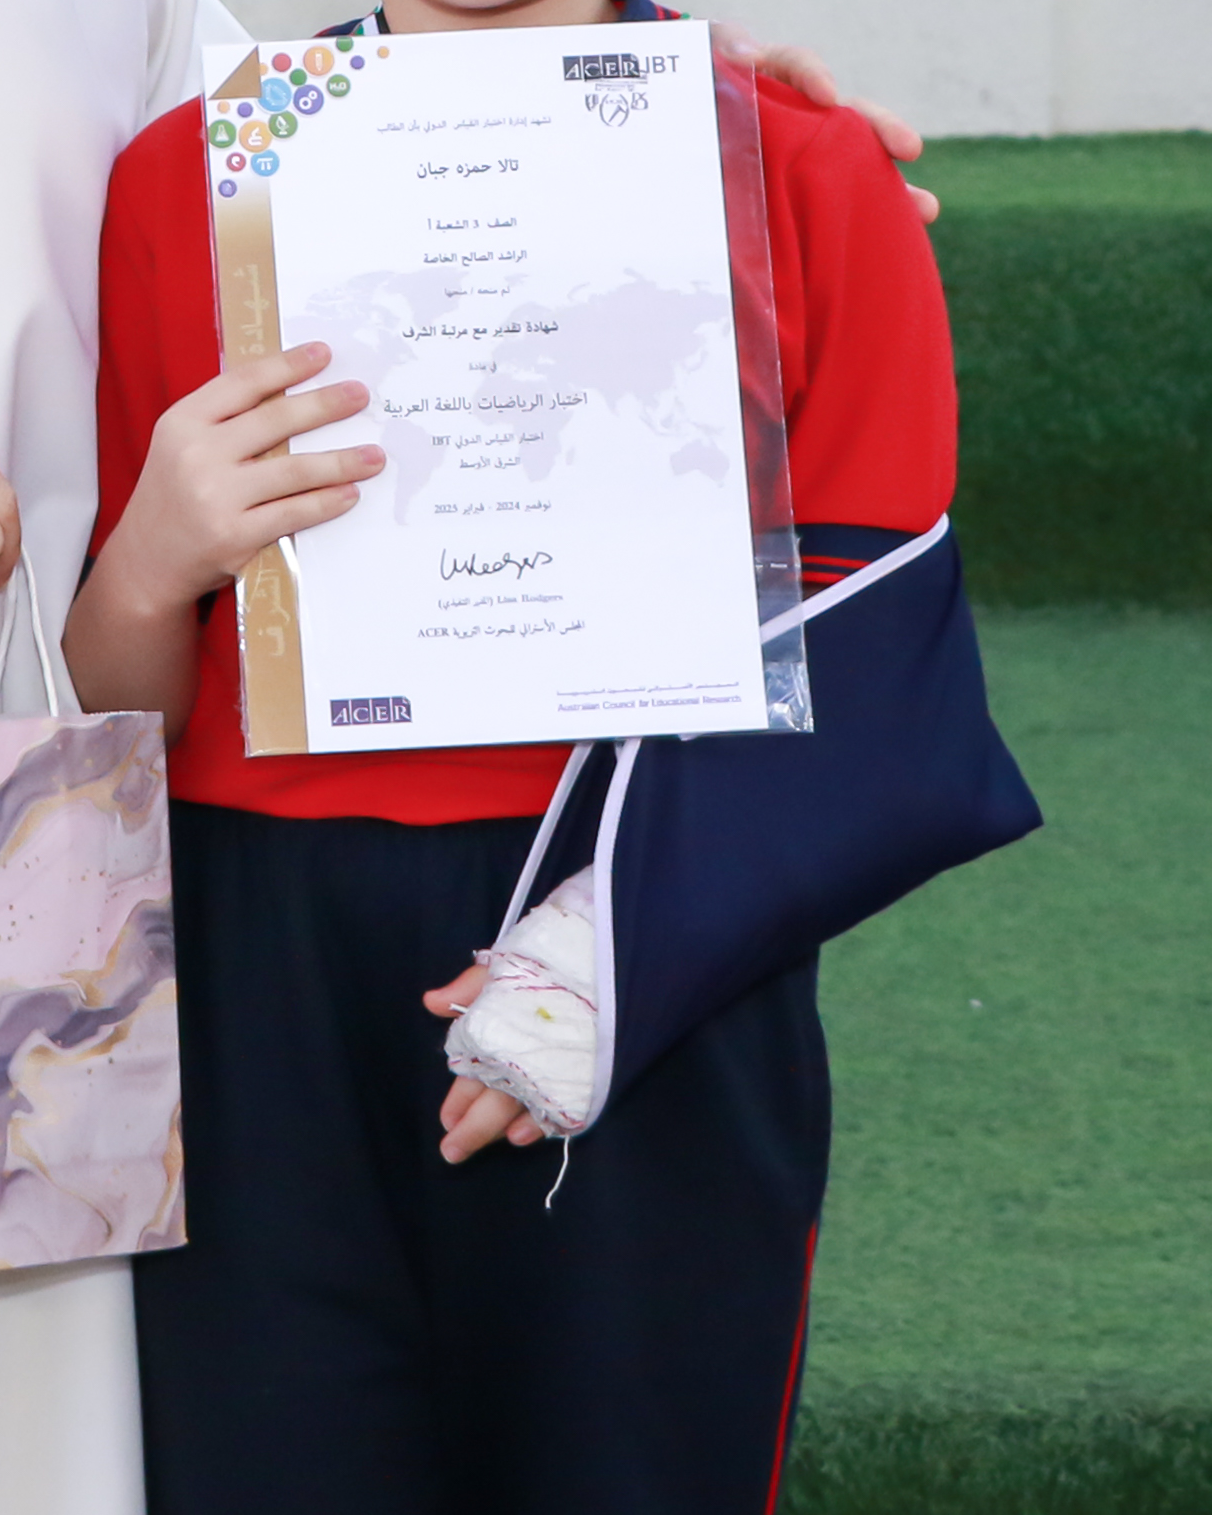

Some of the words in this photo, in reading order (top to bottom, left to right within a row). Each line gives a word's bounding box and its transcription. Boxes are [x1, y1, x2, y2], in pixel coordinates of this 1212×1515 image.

[564, 58, 640, 80] ACER
[456, 163, 493, 179] حمزه
[435, 219, 469, 233] الشعبة
[486, 217, 518, 229] الصف
[422, 252, 458, 264] الخاصة
[461, 251, 494, 267] الصالح
[497, 249, 528, 264] الراشد
[402, 325, 437, 342] الشرف
[440, 324, 469, 340] مرتبة
[472, 327, 488, 341] مع
[492, 322, 522, 338] تقدير
[525, 320, 559, 335] شهادة
[383, 398, 429, 418] العربية
[434, 396, 472, 415] باللغة
[477, 393, 544, 414] الرياضيات
[548, 392, 588, 411] اختبار
[454, 434, 482, 450] الدولي
[459, 455, 491, 470] الأوسط
[493, 456, 521, 470] الشرق
[417, 627, 450, 638] ACER
[602, 699, 636, 710] Council
[638, 698, 650, 708] for
[702, 694, 743, 704] Research
[332, 702, 412, 724] ACER
